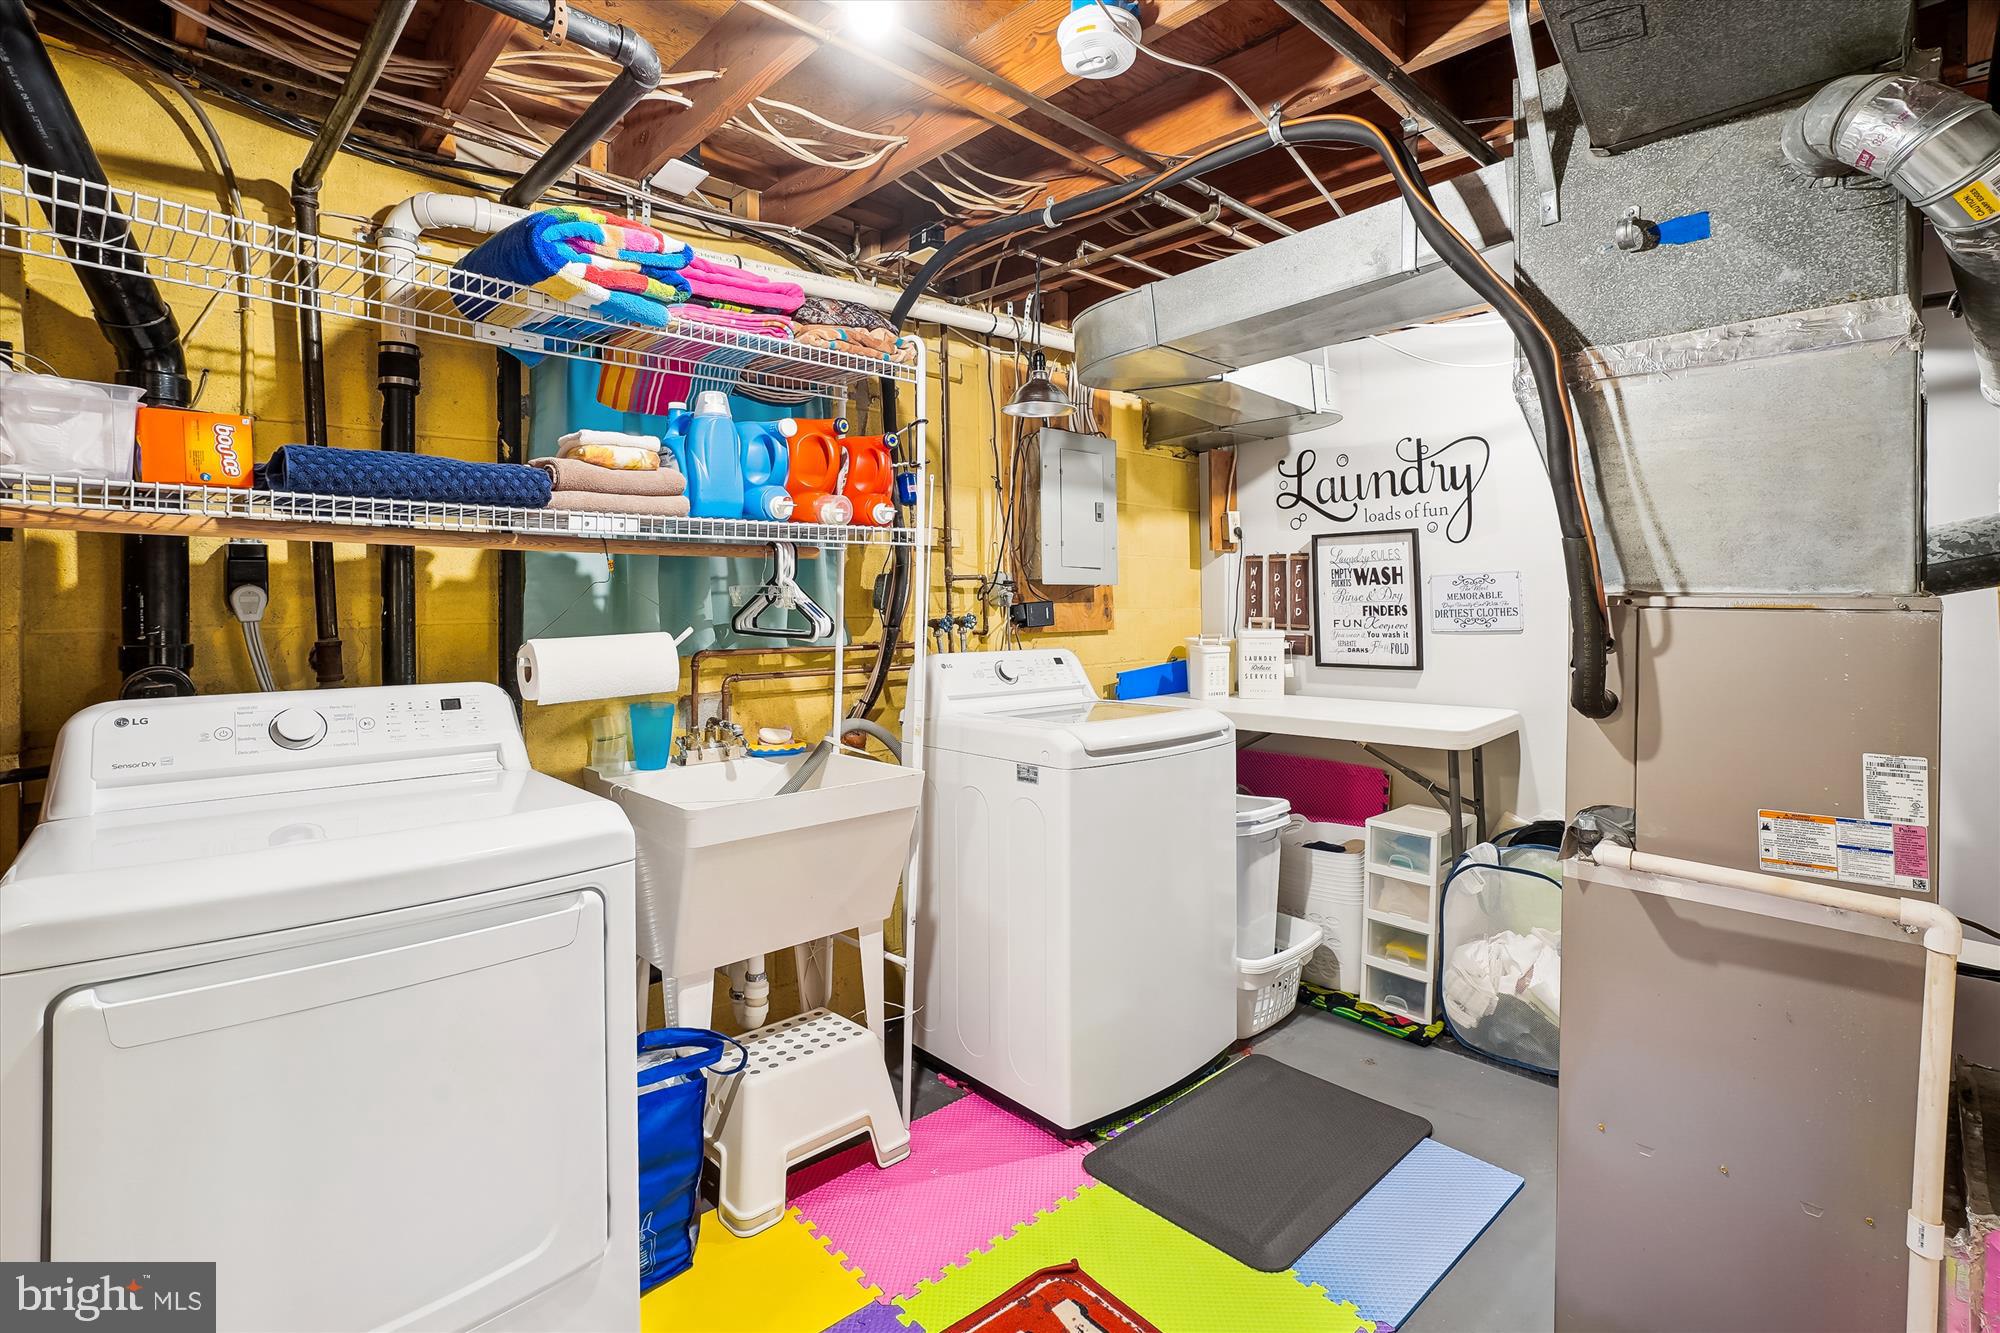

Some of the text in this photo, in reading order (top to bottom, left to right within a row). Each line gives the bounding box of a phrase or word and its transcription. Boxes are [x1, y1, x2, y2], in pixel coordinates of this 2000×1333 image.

[213, 423, 241, 479] bounce
[1276, 435, 1490, 544] Laundry
[1364, 501, 1449, 523] loads of fun
[1370, 548, 1401, 561] RULES
[1330, 568, 1352, 580] EMPTY
[1353, 565, 1404, 586] WASH
[1330, 578, 1352, 588] POCKETS
[1249, 566, 1258, 617] WASH
[1273, 573, 1281, 611] DRY
[1294, 564, 1302, 617] FOLD
[1331, 587, 1364, 604] Rinse
[1378, 586, 1404, 605] Dry
[1446, 591, 1504, 601] MEMORABLE
[1362, 604, 1408, 617] FINDERS
[1434, 606, 1519, 619] DIRTIEST CLOTHES
[1333, 619, 1362, 628] FUN
[1363, 616, 1409, 631] Keepers
[1367, 630, 1409, 638] You wash it
[1390, 642, 1410, 655] FOLD
[132, 717, 149, 726] LG
[111, 760, 157, 770] Sensor Dry
